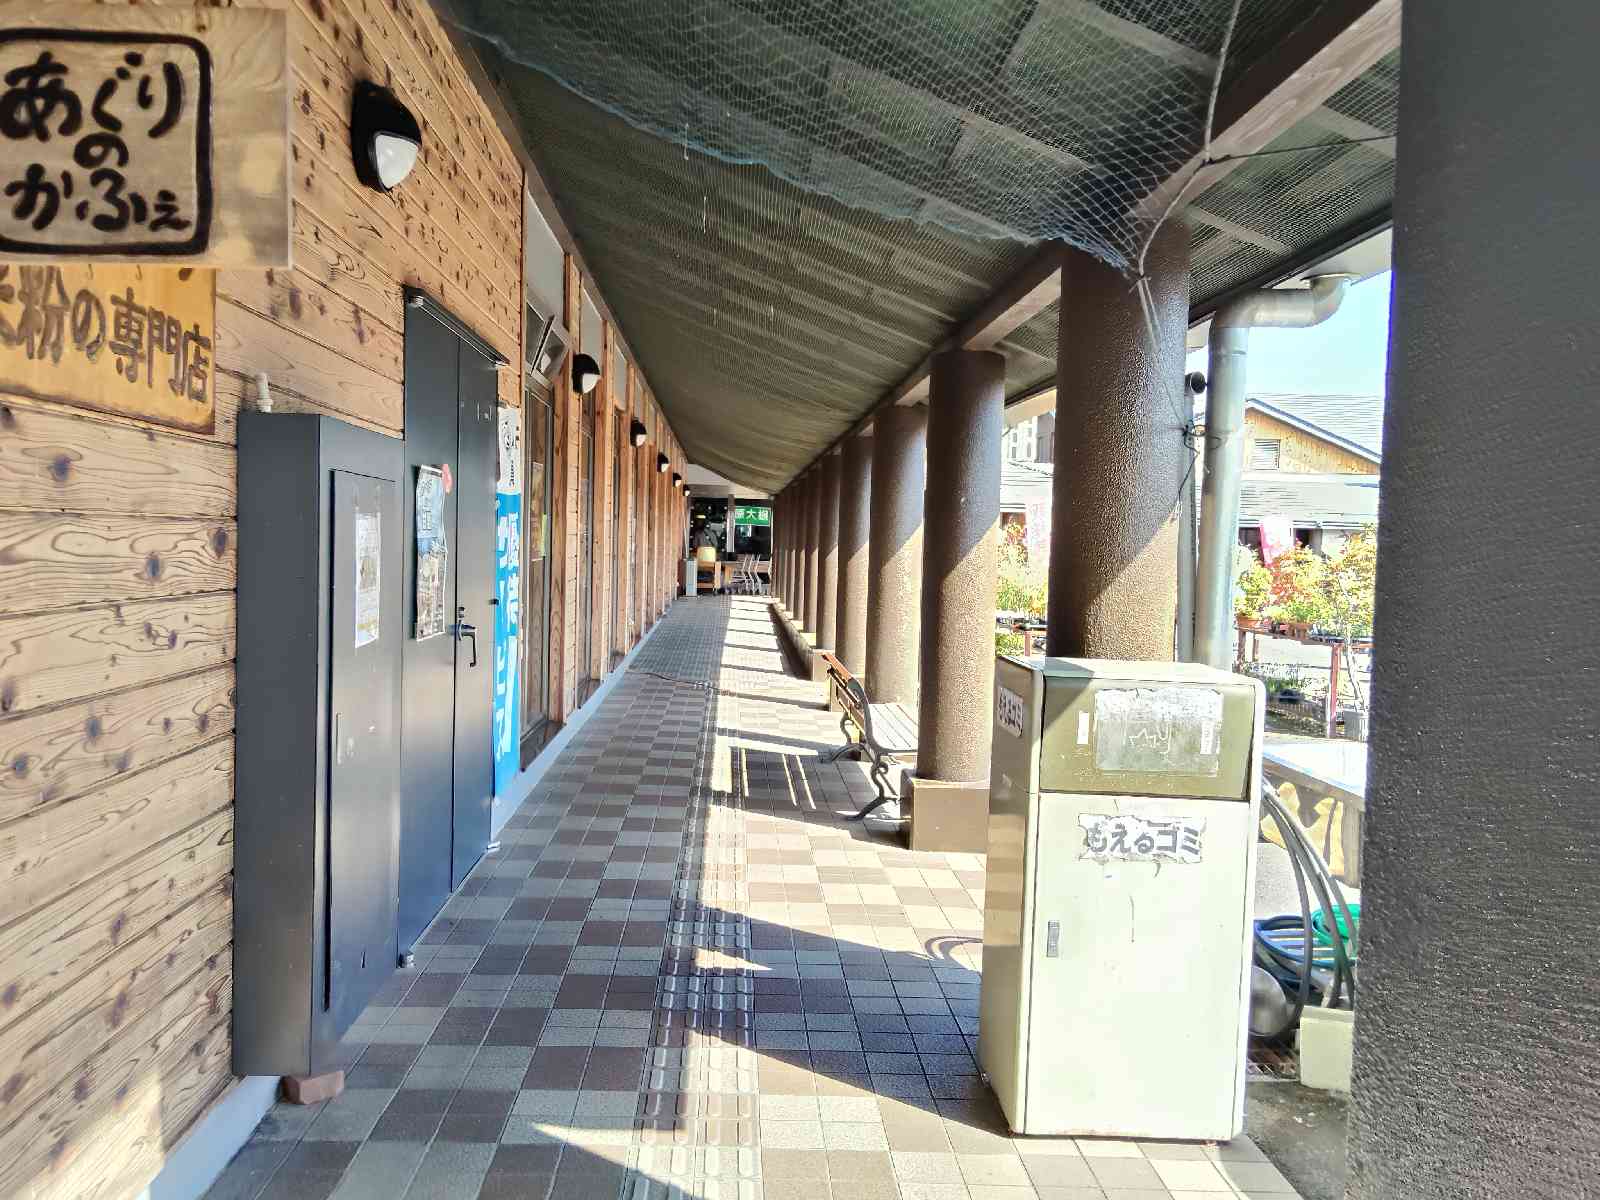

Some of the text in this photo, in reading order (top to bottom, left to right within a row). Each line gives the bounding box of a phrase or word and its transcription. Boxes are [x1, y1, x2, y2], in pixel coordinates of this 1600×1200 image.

[0, 51, 185, 142] あぐり
[73, 132, 130, 169] の
[4, 163, 192, 232] かふぇ
[0, 265, 212, 404] 粉の専門店
[1087, 821, 1201, 855] もえるゴミ
